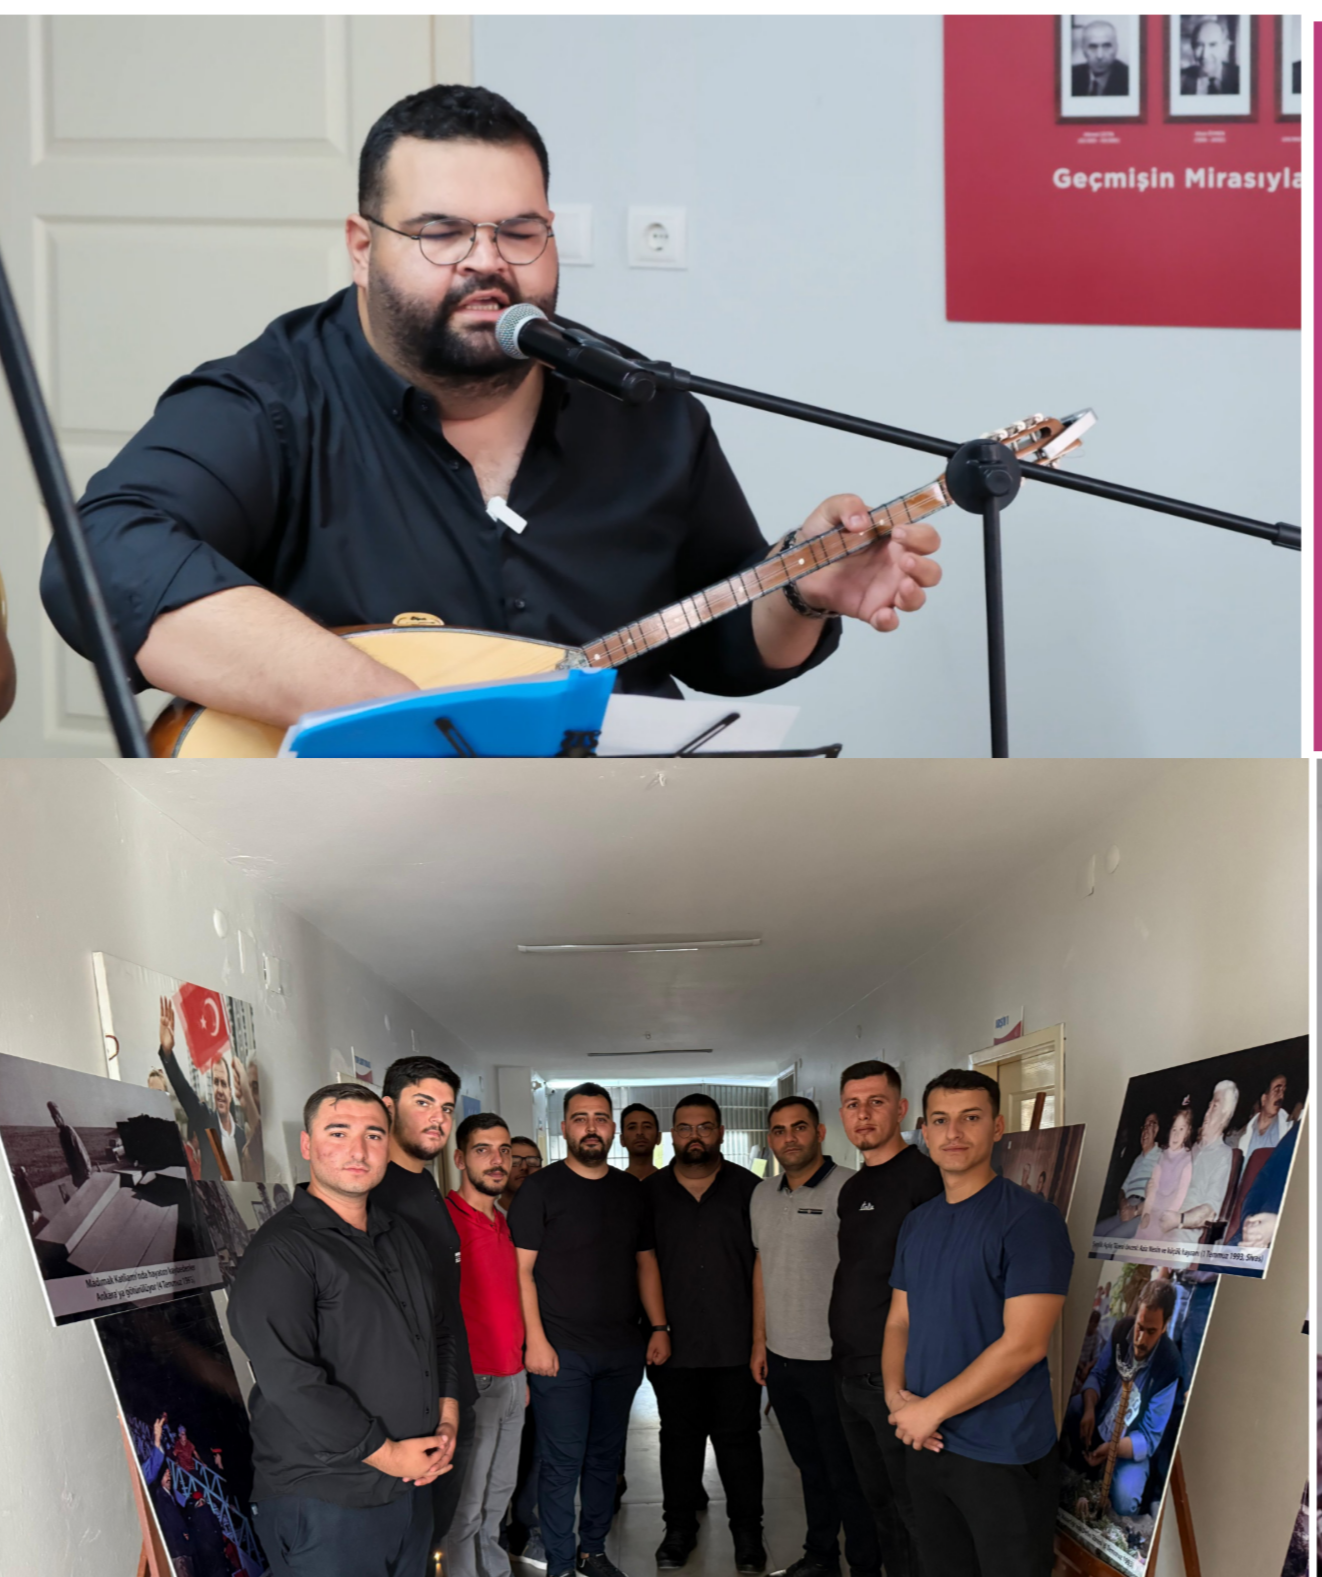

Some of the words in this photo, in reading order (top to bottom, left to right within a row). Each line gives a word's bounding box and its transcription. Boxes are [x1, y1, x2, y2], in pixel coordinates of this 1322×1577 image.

[1053, 168, 1174, 192] Geçmişin
[1185, 168, 1302, 192] Mirasıyla
[1207, 1249, 1229, 1260] Temmuz
